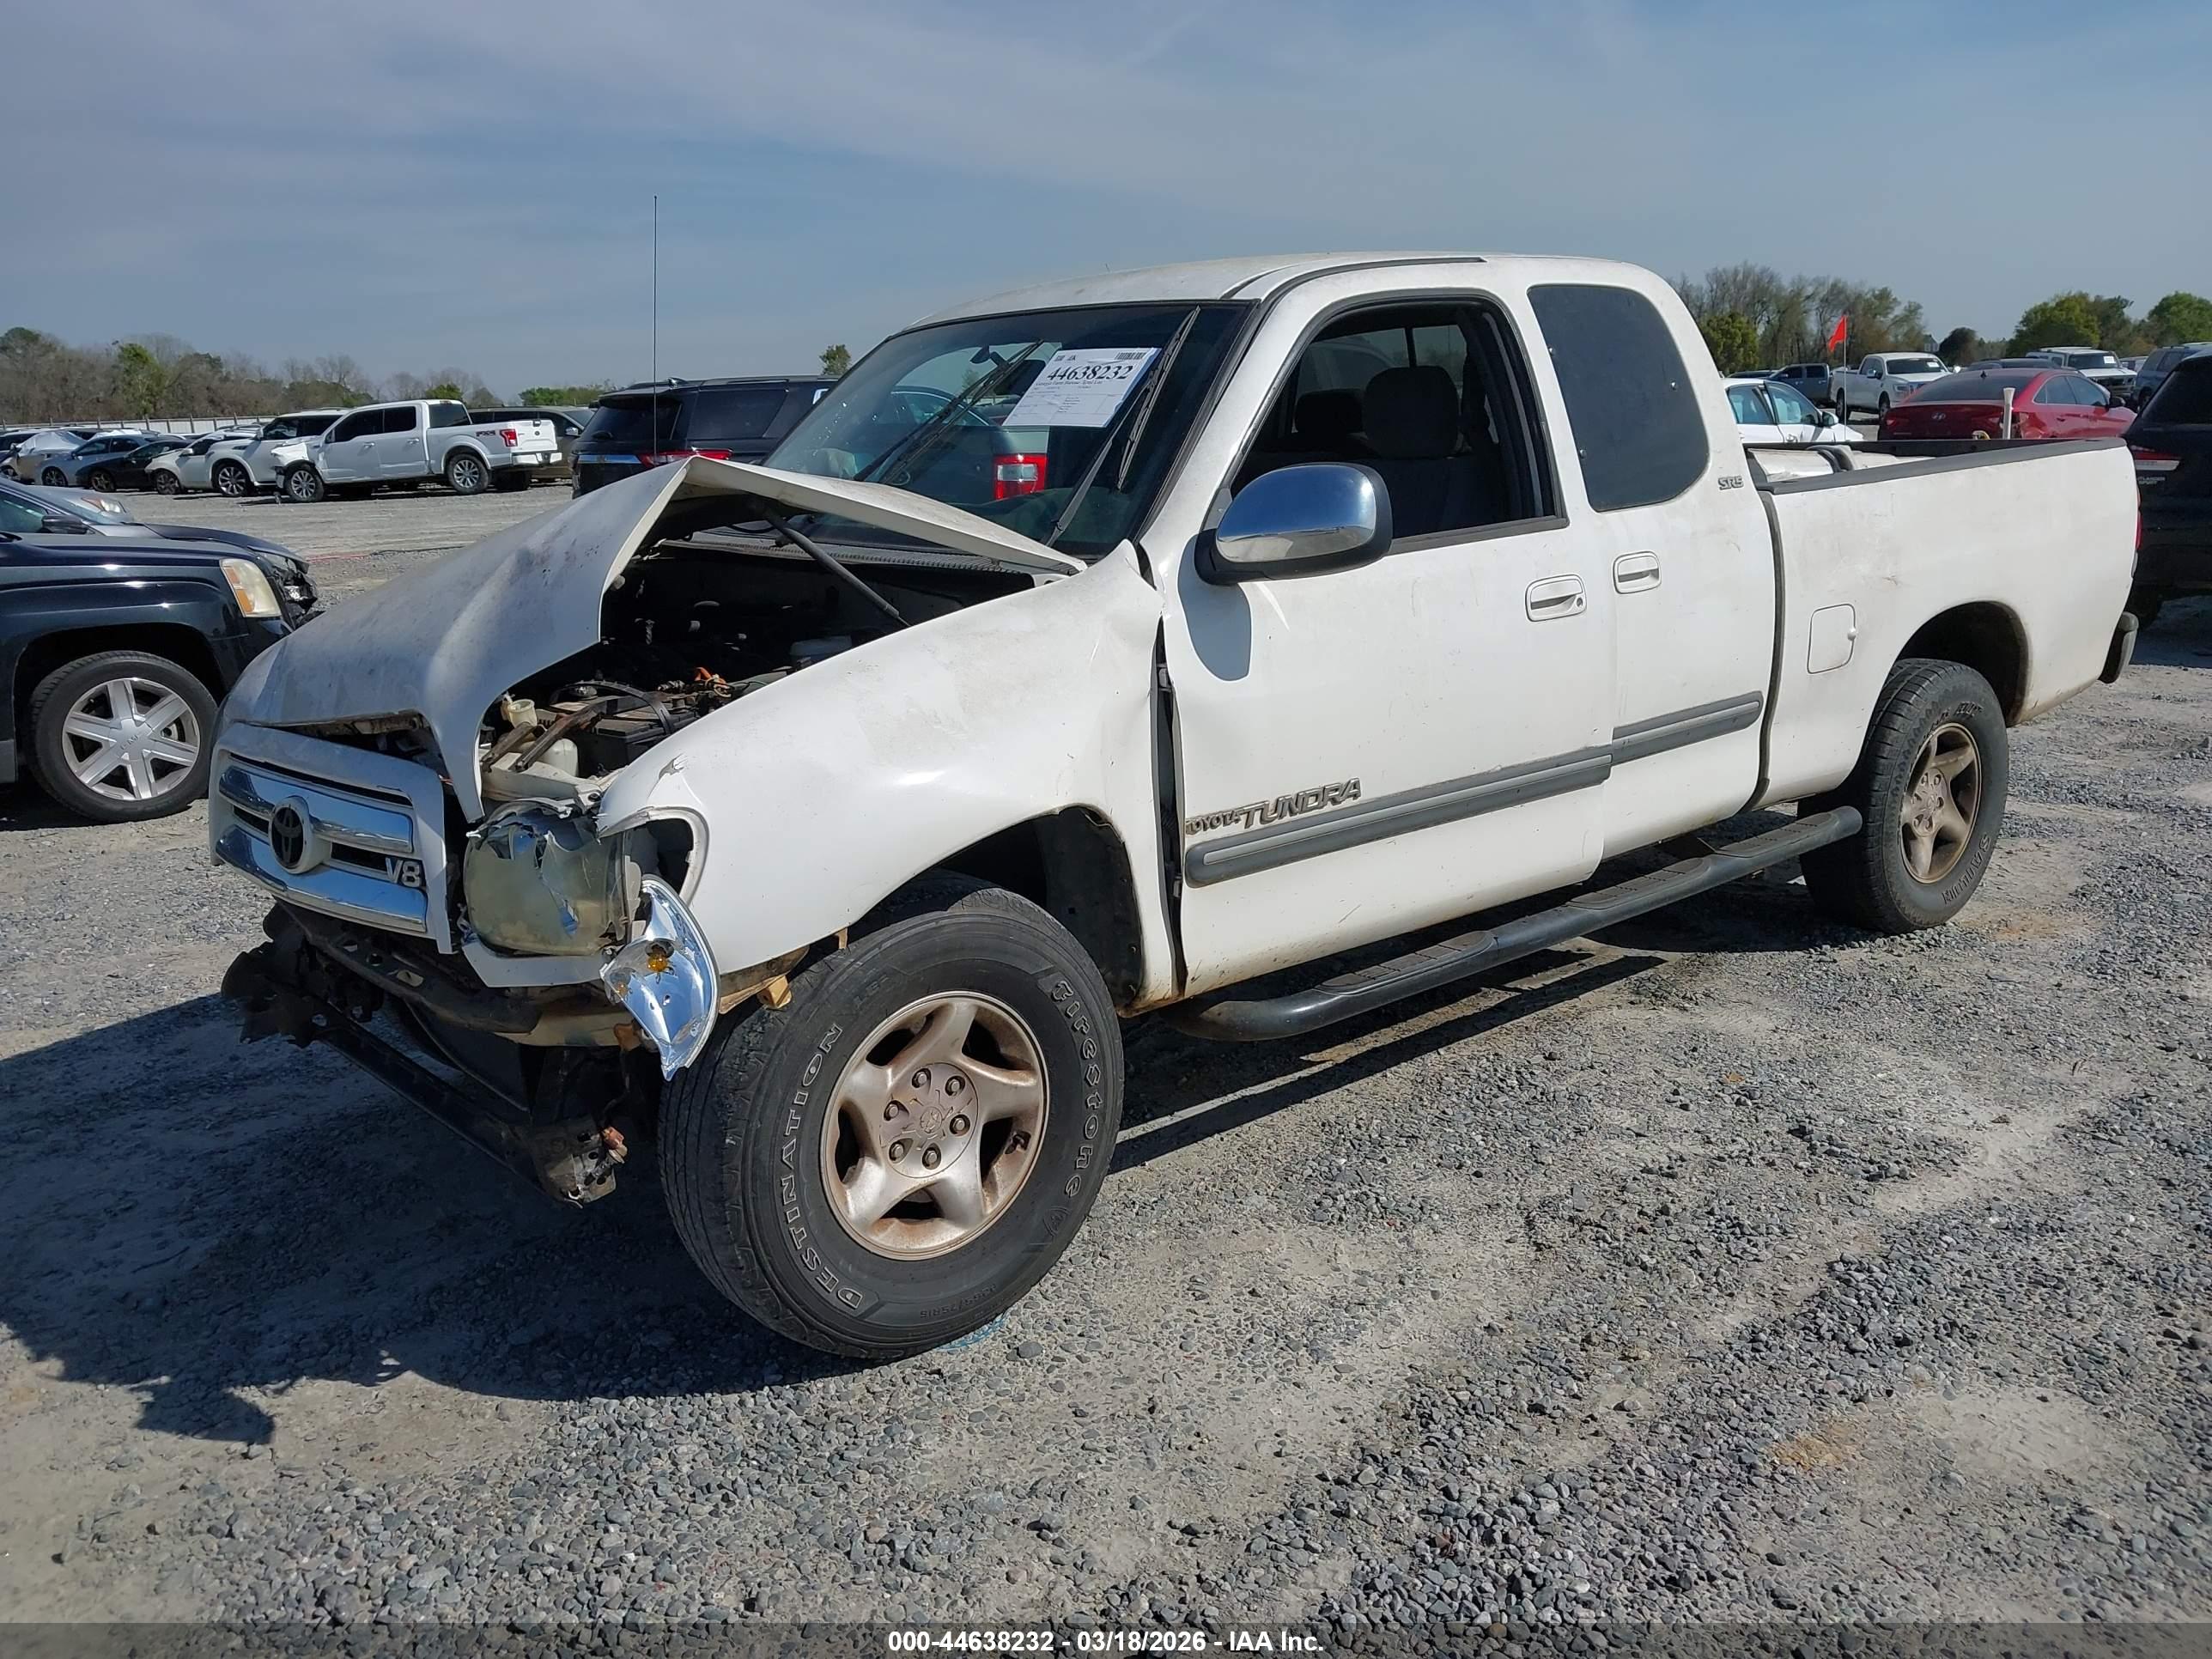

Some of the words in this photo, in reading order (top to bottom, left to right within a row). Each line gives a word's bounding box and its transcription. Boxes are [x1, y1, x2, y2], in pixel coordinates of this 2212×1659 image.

[1047, 365, 1133, 380] 44638232
[1717, 475, 1745, 490] SR5
[1238, 777, 1363, 830] TUNDRA
[386, 857, 422, 888] V8
[1051, 980, 1103, 1198] Firestone
[781, 1023, 864, 1310] DESTINATION
